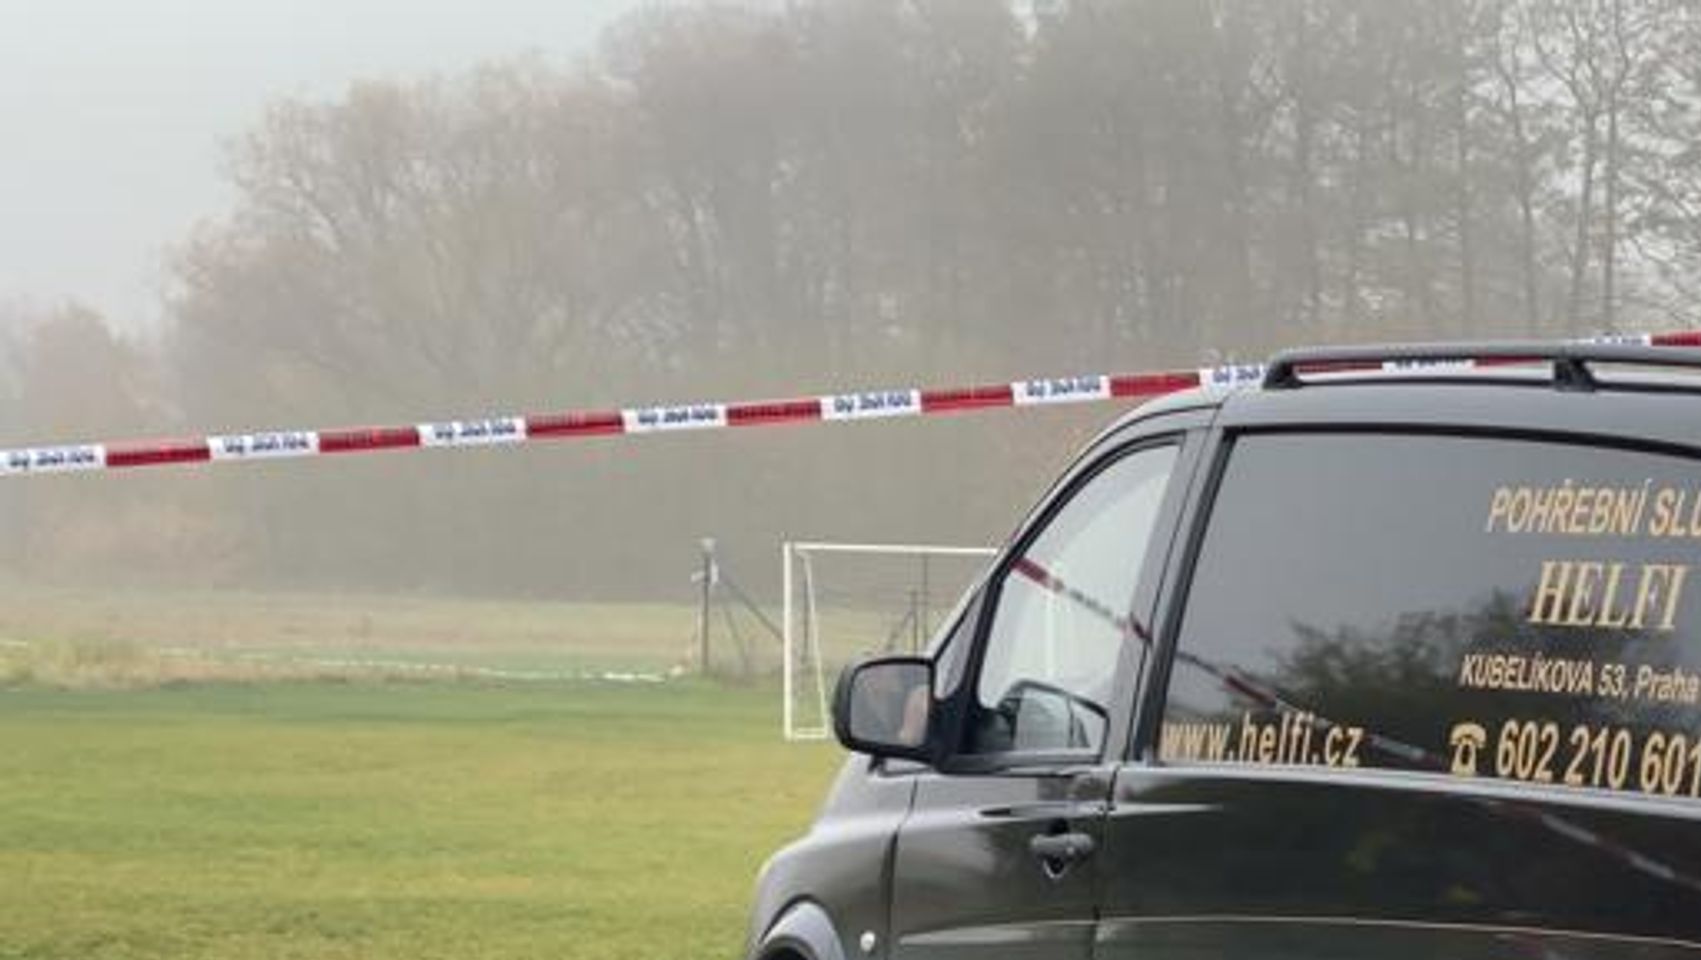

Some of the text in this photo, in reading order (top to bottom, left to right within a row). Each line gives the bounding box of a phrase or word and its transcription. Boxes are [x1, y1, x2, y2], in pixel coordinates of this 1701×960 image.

[1486, 478, 1650, 535] POHŘEBNÍ
[1528, 560, 1688, 631] HELFI
[1459, 651, 1593, 694] KUBELÍKOVA
[1597, 663, 1629, 701] 53,
[1633, 667, 1700, 703] Praha
[1160, 709, 1364, 768] www.helfi.cz
[1496, 719, 1558, 784] 602
[1562, 725, 1629, 790] 210
